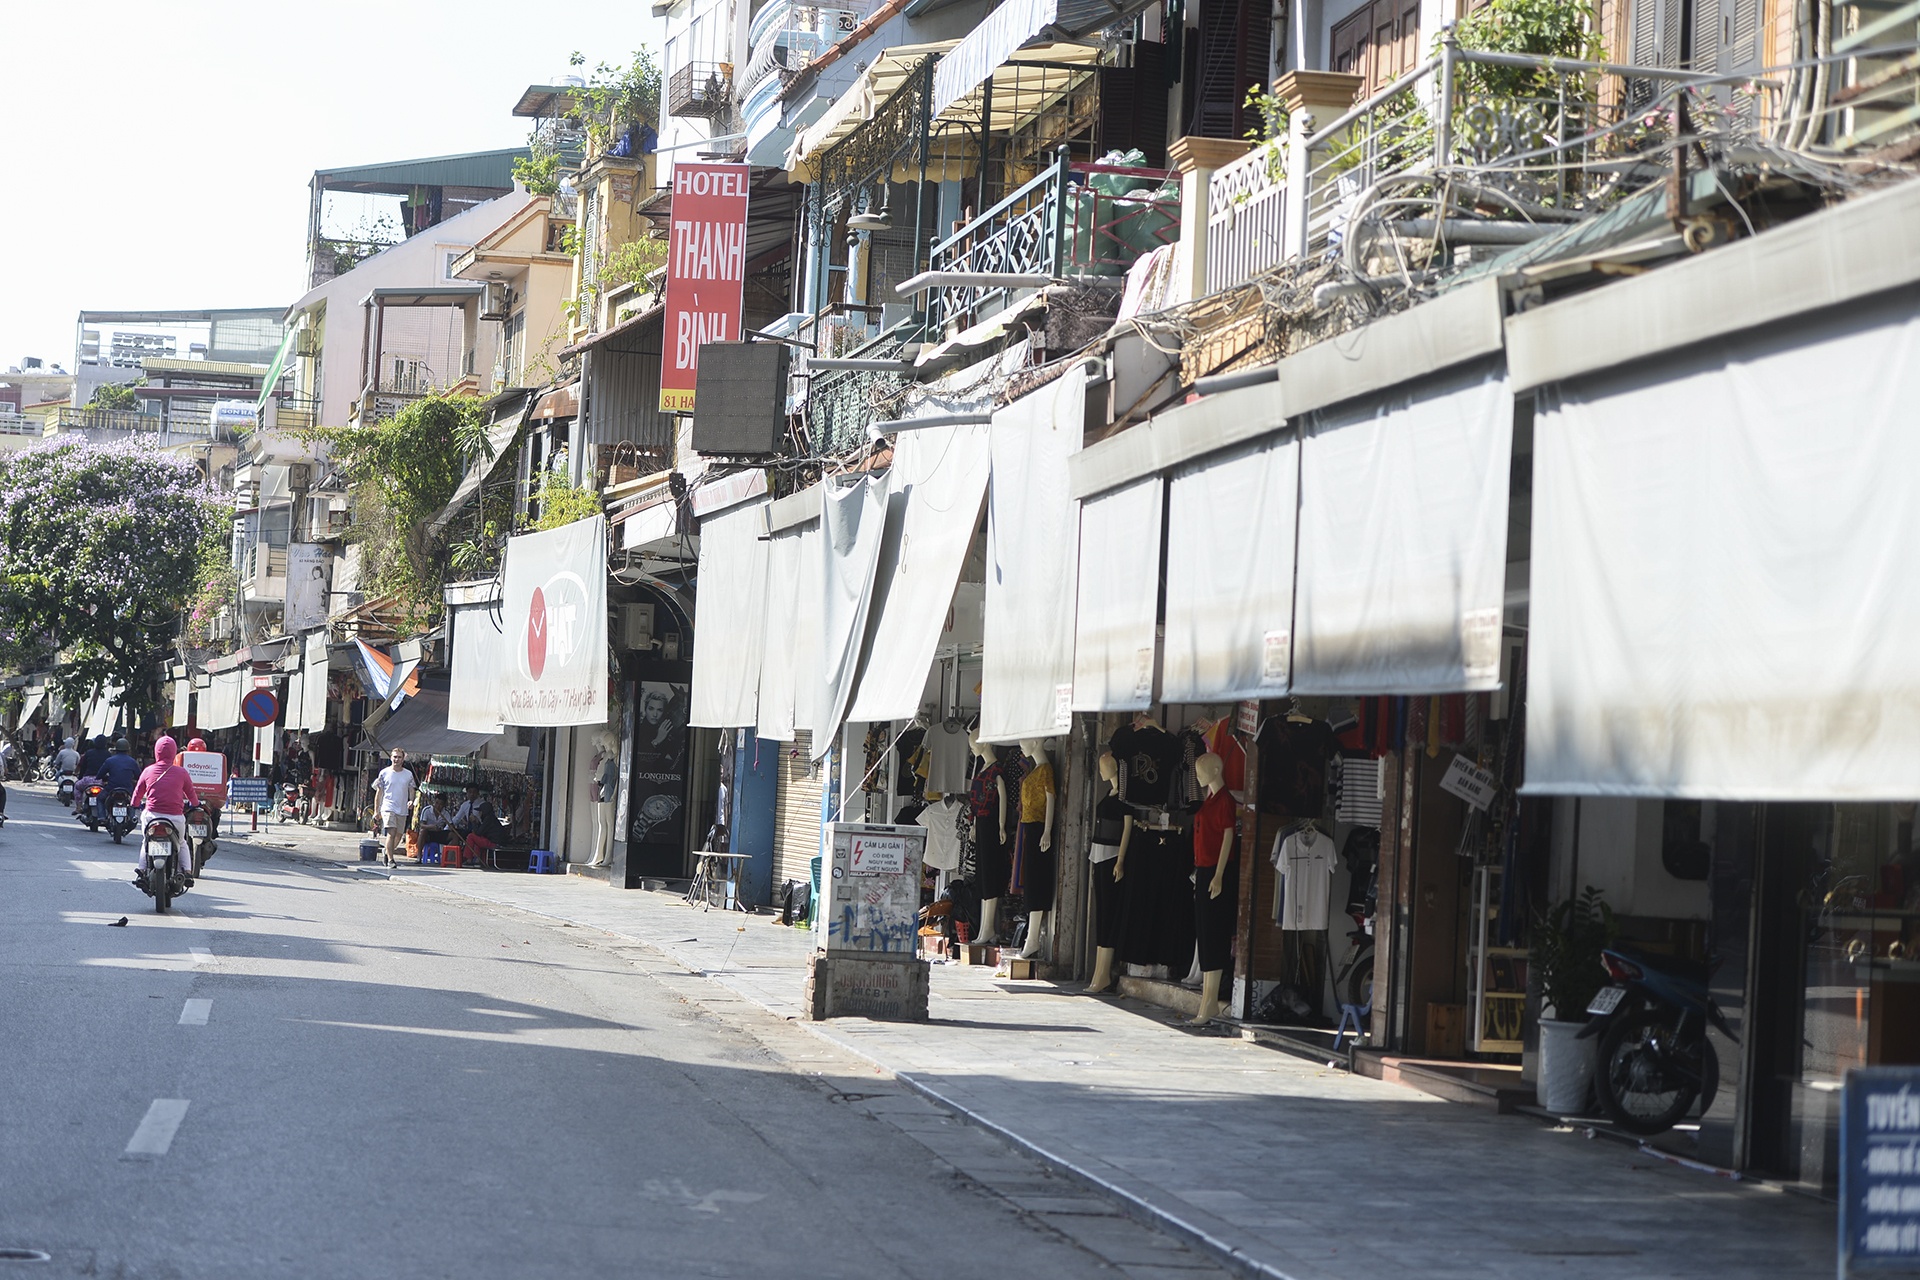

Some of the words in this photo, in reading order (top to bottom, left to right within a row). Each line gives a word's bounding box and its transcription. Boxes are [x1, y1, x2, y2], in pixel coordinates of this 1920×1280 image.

[677, 171, 747, 197] HOTEL
[675, 220, 744, 281] THANH
[664, 395, 676, 408] 81
[639, 772, 681, 781] LONGINES
